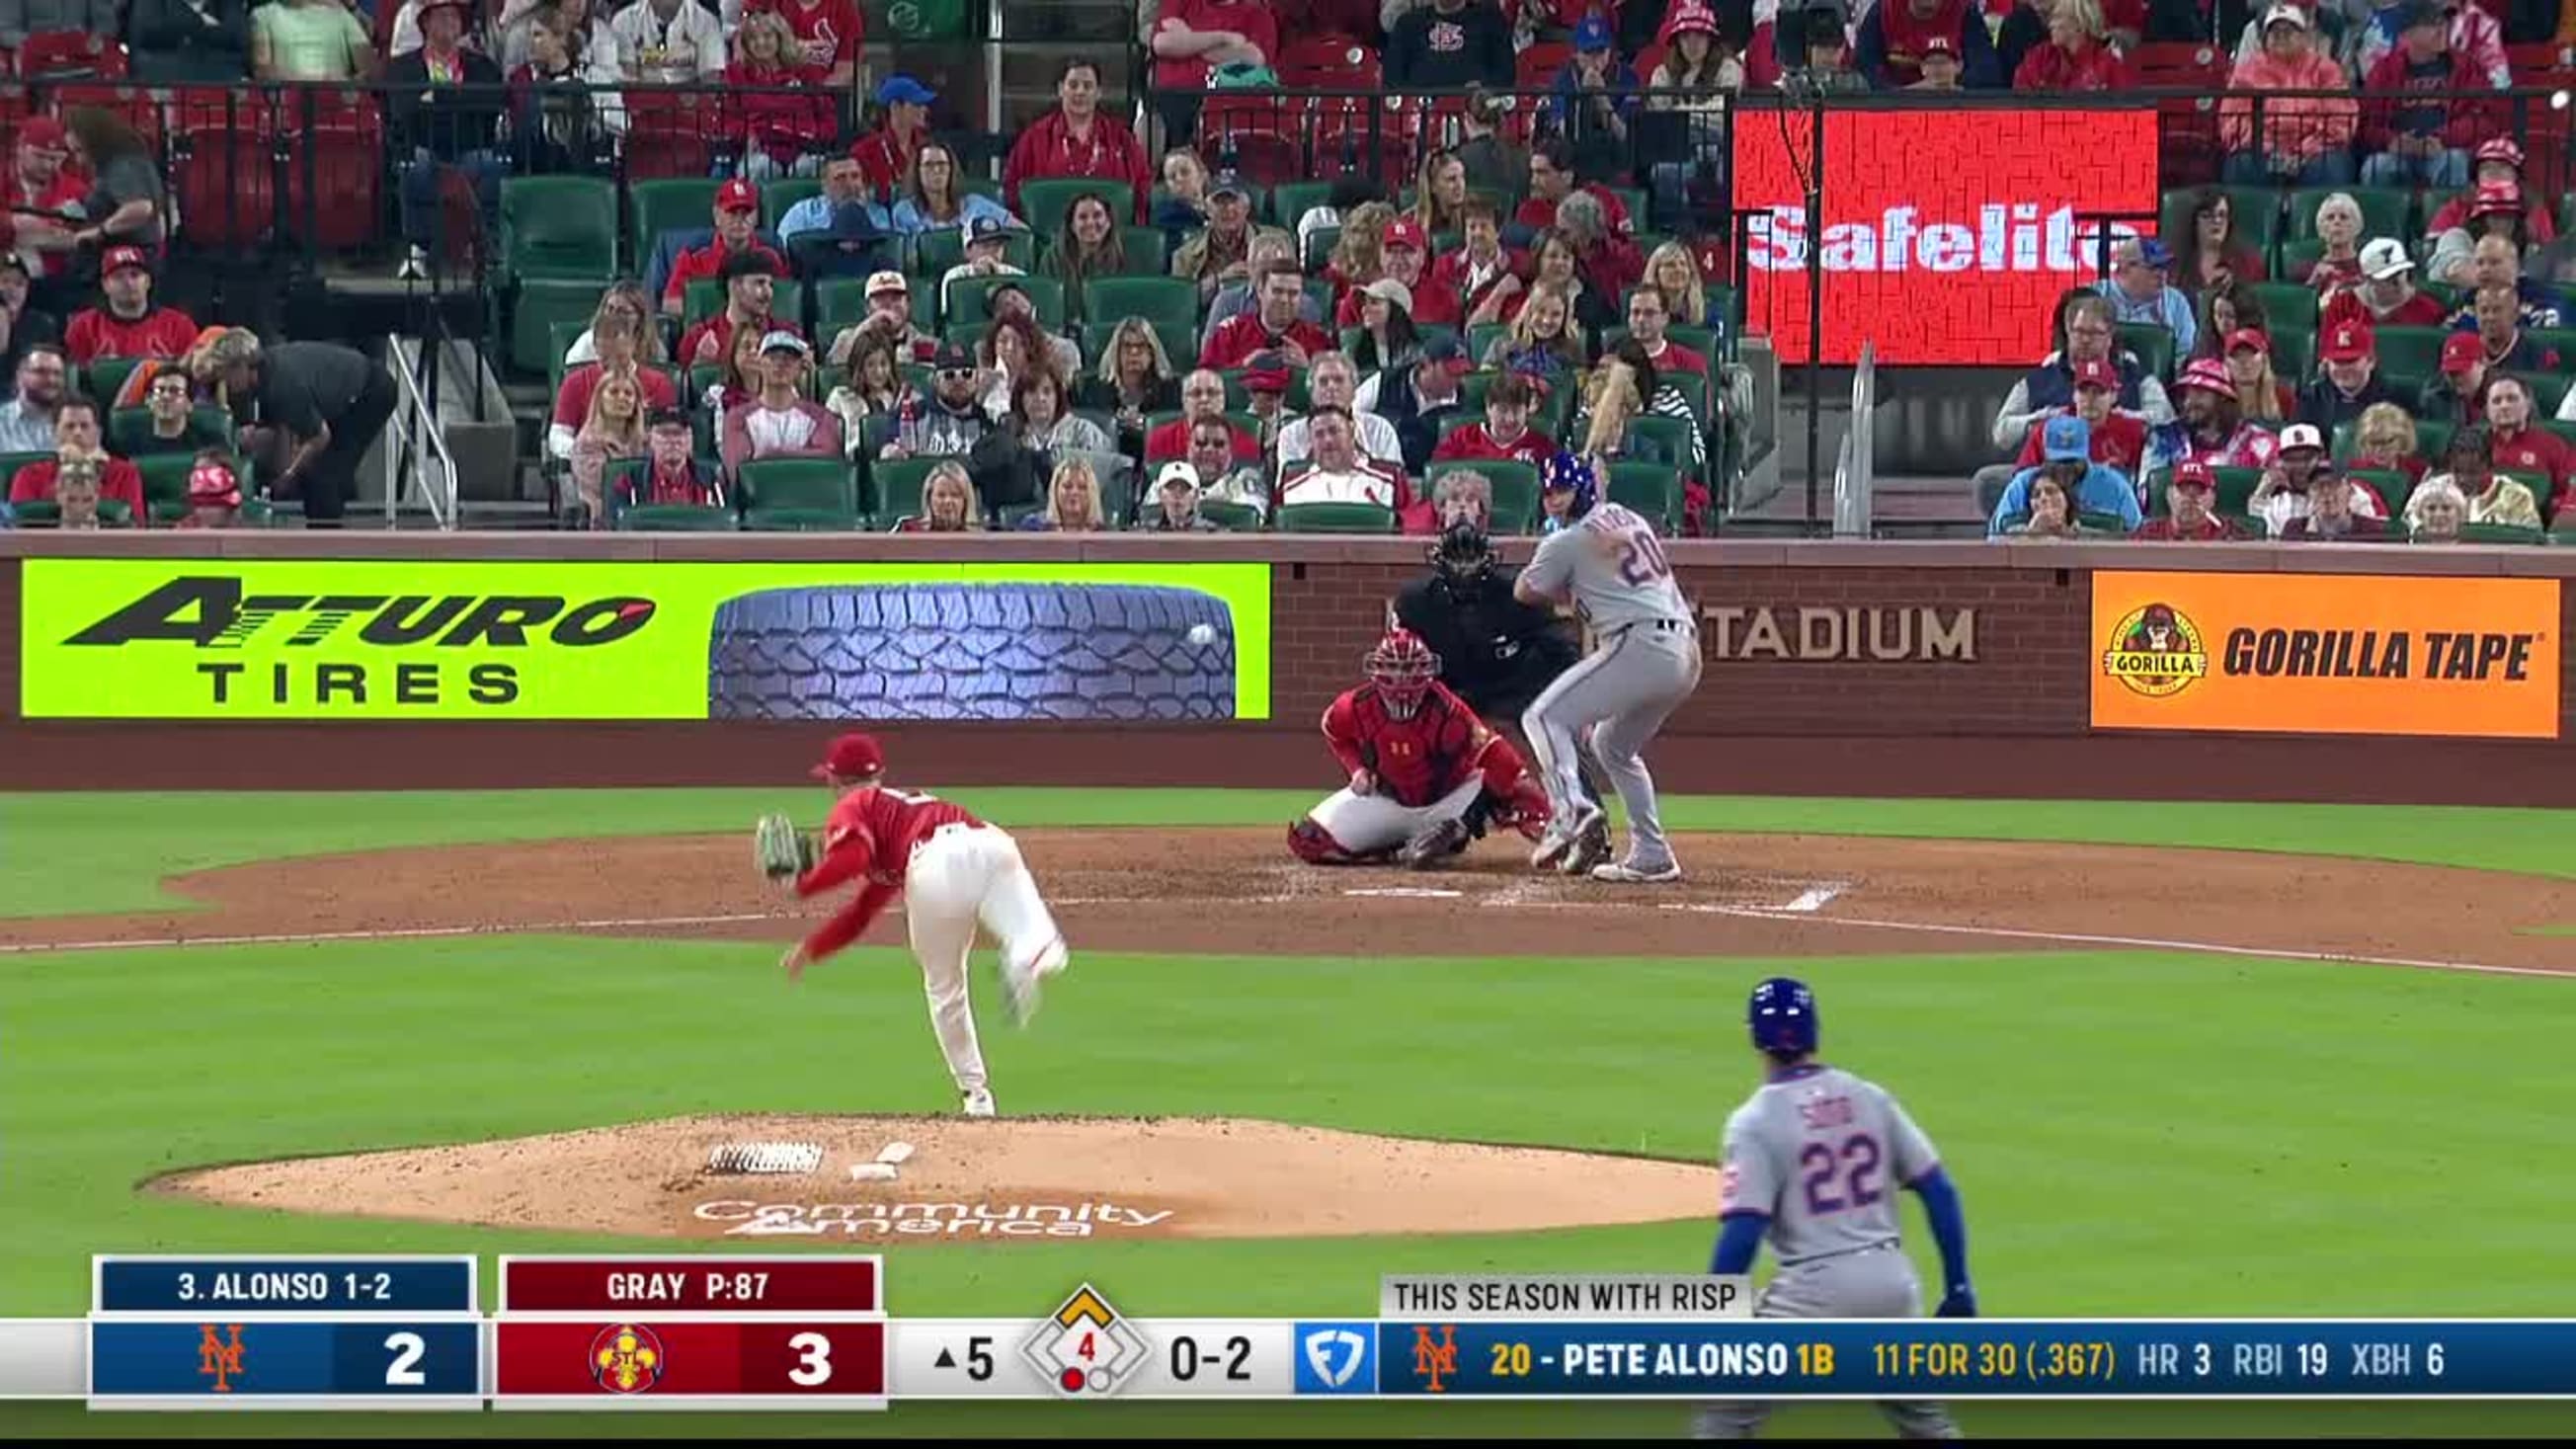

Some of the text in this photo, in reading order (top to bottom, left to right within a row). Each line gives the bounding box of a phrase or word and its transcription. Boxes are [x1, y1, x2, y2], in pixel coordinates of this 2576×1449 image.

[1747, 203, 2138, 273] Safelite
[1619, 529, 1669, 579] 20
[63, 576, 657, 648] ATTURO
[1701, 605, 1977, 661] TADIUM
[2116, 655, 2195, 674] GORILLA
[2223, 627, 2410, 679] GORILLA
[2424, 632, 2533, 681] TAPE
[197, 663, 520, 704] TIRES
[1801, 1132, 1882, 1215] 22
[693, 1199, 1173, 1227] Community
[724, 1210, 1092, 1237] America
